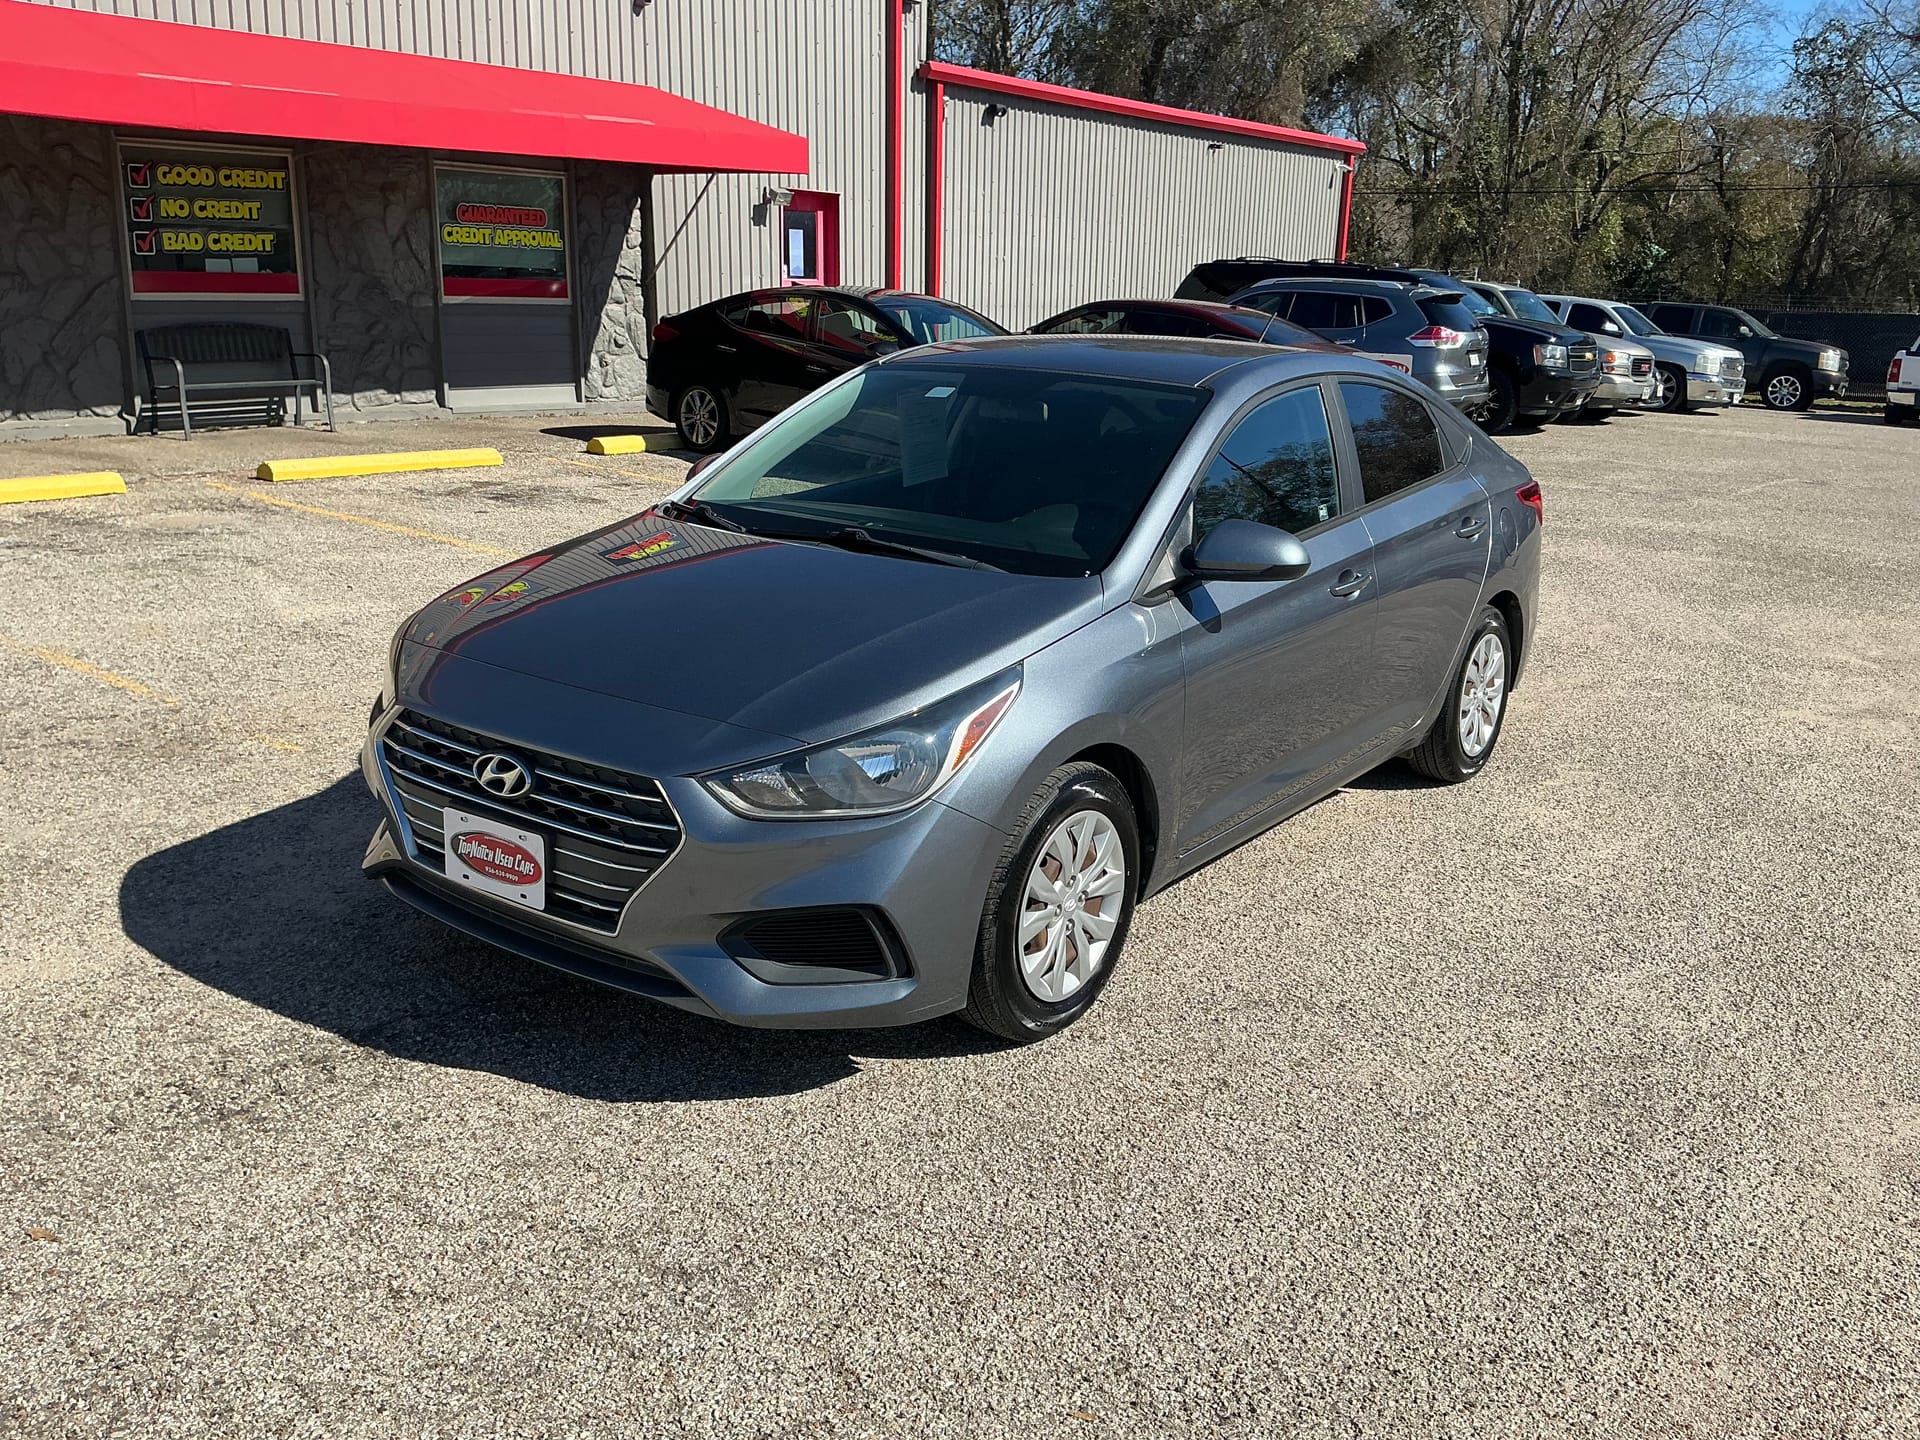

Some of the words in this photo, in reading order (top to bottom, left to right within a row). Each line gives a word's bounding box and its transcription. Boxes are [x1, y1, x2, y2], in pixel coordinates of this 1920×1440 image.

[156, 164, 215, 187] GOOD
[218, 168, 286, 189] CREDIT
[160, 198, 190, 217] NO
[193, 200, 261, 220] CREDIT
[458, 204, 546, 227] GUARANTEED
[162, 231, 204, 251] BAD
[207, 233, 274, 252] CREDIT
[444, 226, 492, 245] CREDIT
[494, 228, 562, 249] APPROVAL
